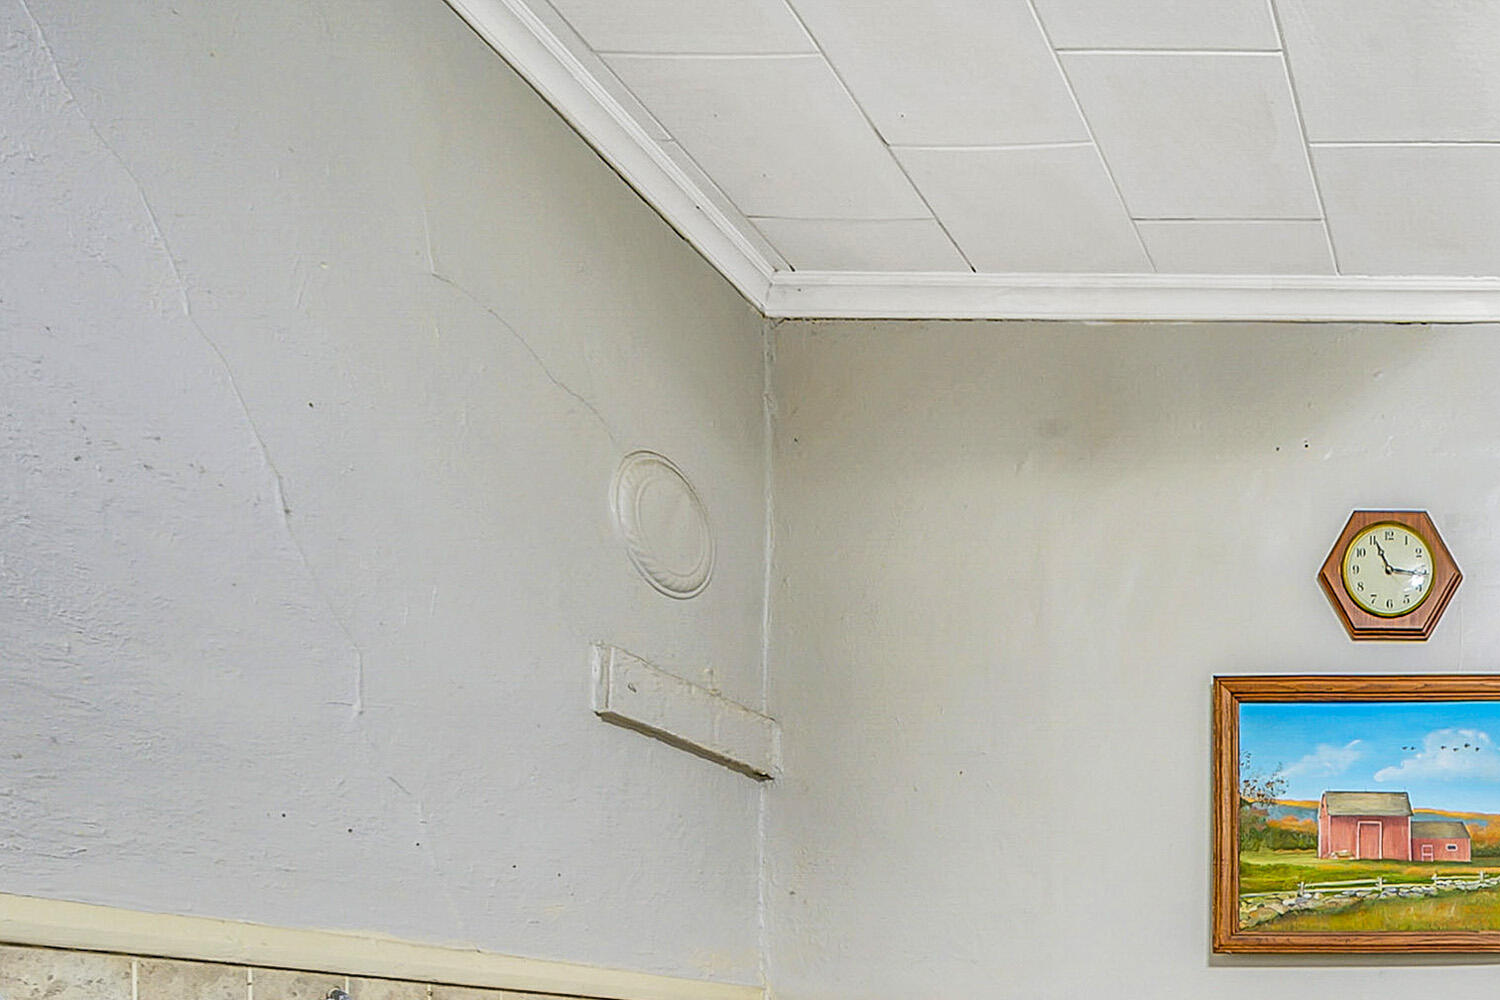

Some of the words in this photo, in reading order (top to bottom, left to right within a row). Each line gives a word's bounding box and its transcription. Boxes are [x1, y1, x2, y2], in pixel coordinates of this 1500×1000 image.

[1369, 535, 1376, 545] 11
[1385, 531, 1394, 541] 12
[1356, 548, 1366, 558] 10
[1415, 548, 1422, 558] 2
[1352, 565, 1360, 575] 9
[1357, 582, 1364, 592] 8
[1370, 594, 1377, 604] 7
[1386, 599, 1393, 608] 6
[1403, 595, 1410, 604] 5
